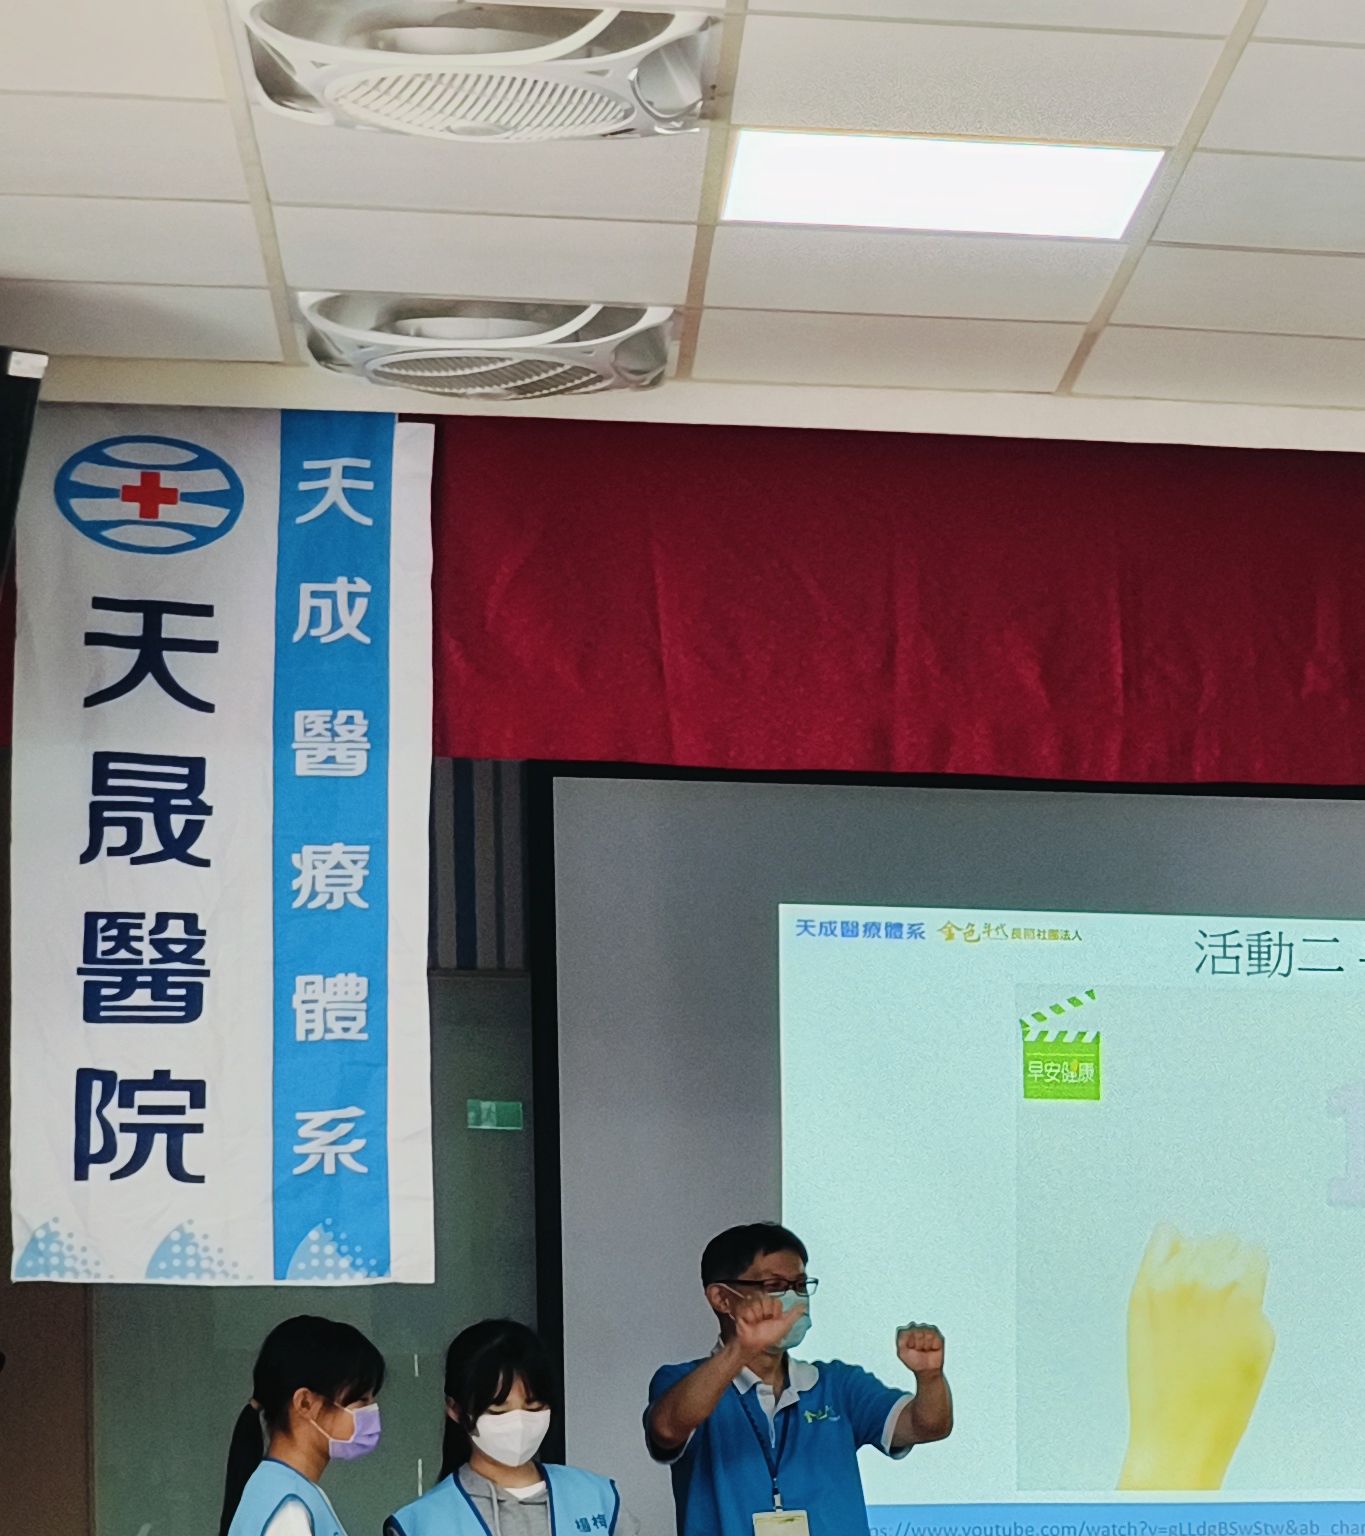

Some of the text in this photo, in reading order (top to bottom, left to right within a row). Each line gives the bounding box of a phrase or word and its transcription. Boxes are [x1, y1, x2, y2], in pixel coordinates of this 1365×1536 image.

[291, 456, 376, 1176] 天成醫療體系
[73, 596, 220, 1185] 天晟醫院
[796, 919, 926, 940] 天成醫療體系
[1195, 929, 1344, 978] 活動二
[1026, 1060, 1095, 1084] 早安健康
